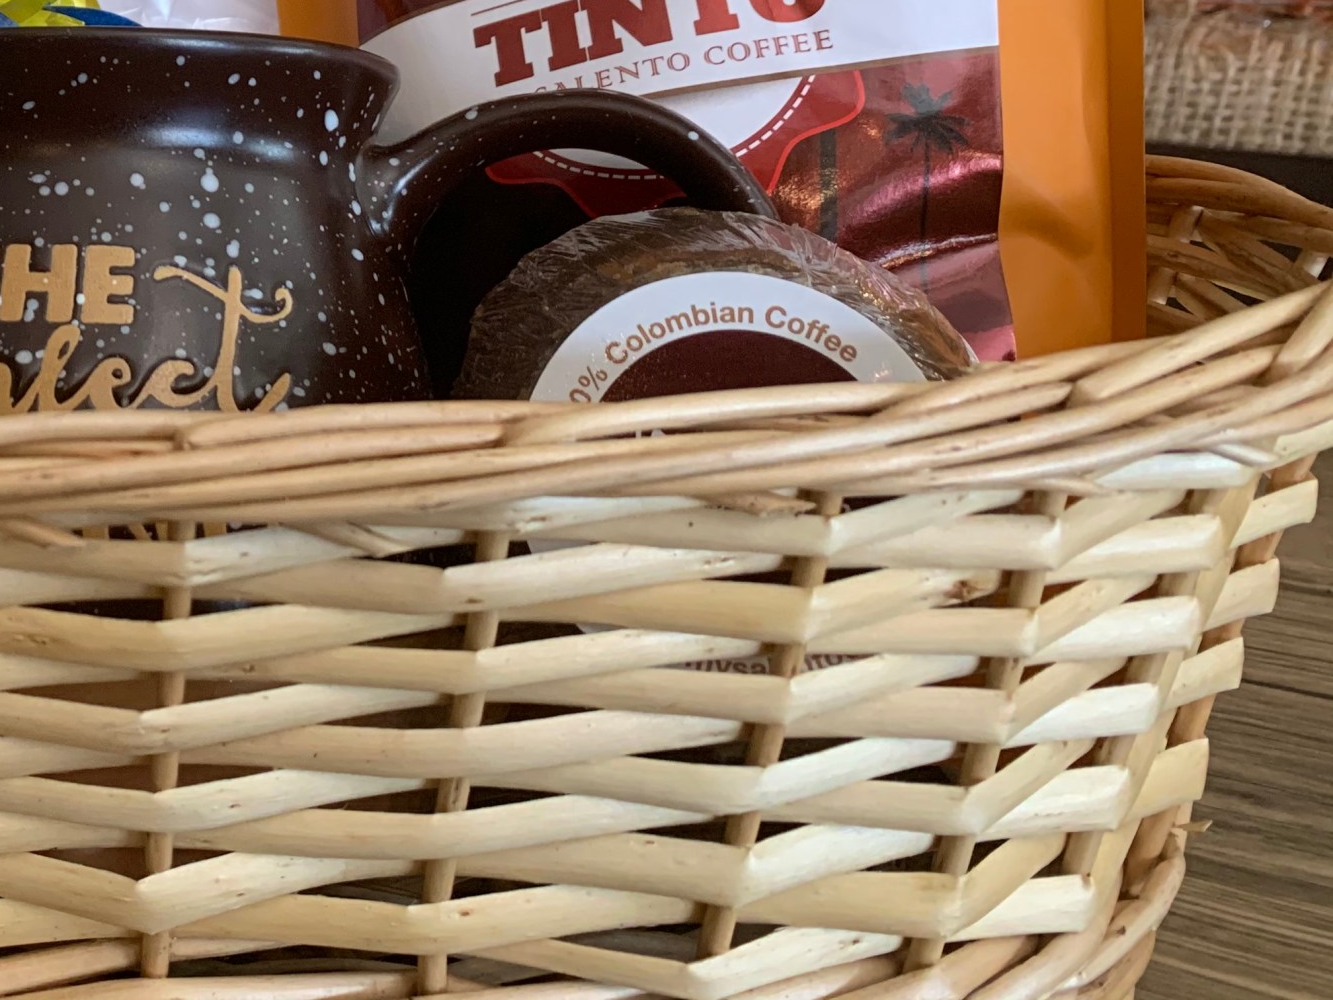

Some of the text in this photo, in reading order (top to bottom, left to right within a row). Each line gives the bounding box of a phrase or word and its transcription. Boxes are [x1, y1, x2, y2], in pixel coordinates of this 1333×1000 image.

[535, 29, 833, 91] LENTO COFFEE
[569, 302, 857, 403] 0% Colombian Coffee
